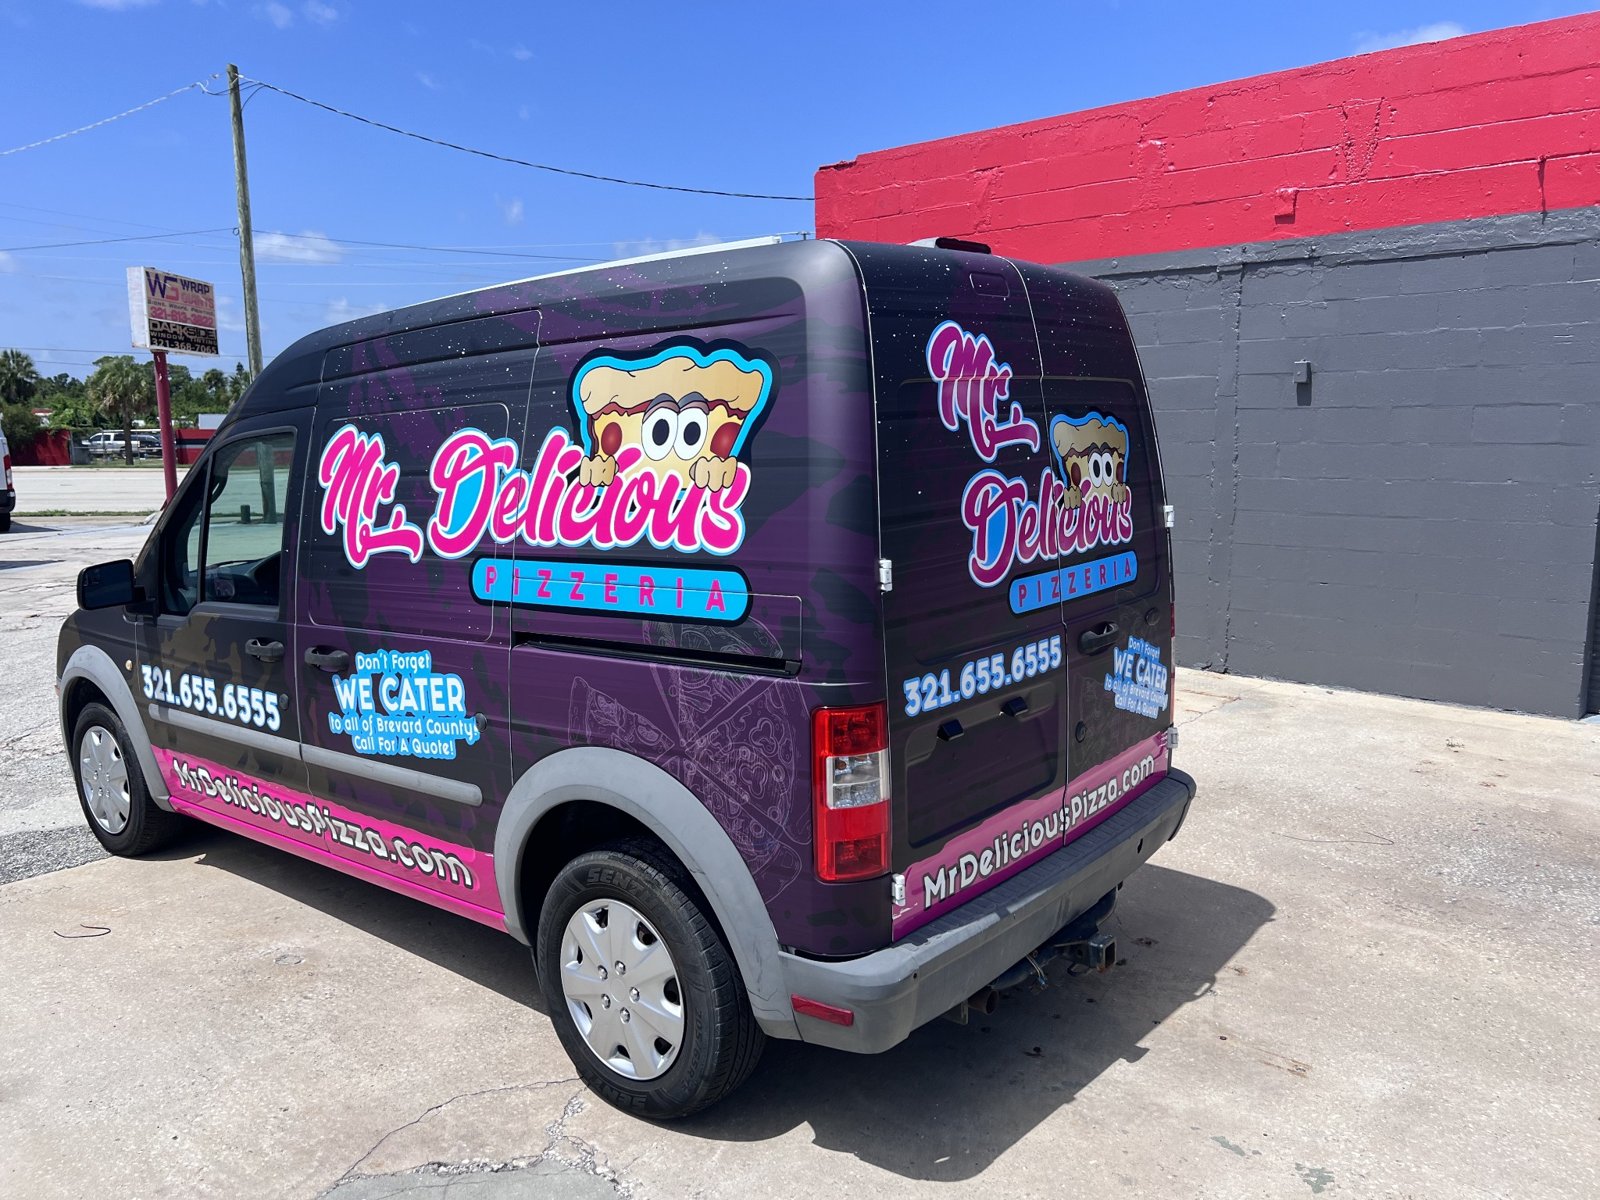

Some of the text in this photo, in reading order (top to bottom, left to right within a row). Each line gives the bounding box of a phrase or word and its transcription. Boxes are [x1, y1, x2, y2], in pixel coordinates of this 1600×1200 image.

[180, 279, 209, 295] WRAP
[149, 320, 215, 339] DARKSIDE
[150, 330, 184, 340] WINDOW
[427, 426, 751, 556] Delicious
[962, 467, 1132, 586] Delicious
[485, 565, 726, 613] PIZZERIA
[1018, 558, 1132, 607] PIZZERIA
[357, 653, 430, 673] Don't Forget
[1114, 648, 1168, 693] WE CATER
[1144, 643, 1160, 660] Forget
[334, 677, 464, 712] WE CATER
[904, 636, 1061, 716] 321.655.6555
[1123, 681, 1130, 696] of
[141, 664, 281, 731] 321.655.6555
[330, 716, 341, 730] to
[345, 716, 359, 731] all
[362, 715, 373, 736] of
[377, 717, 422, 734] Brevard
[354, 735, 454, 755] Call For A Quote!
[172, 758, 473, 888] MrDeliciousPizza.com
[922, 755, 1155, 909] MrDeliciousPizza.com
